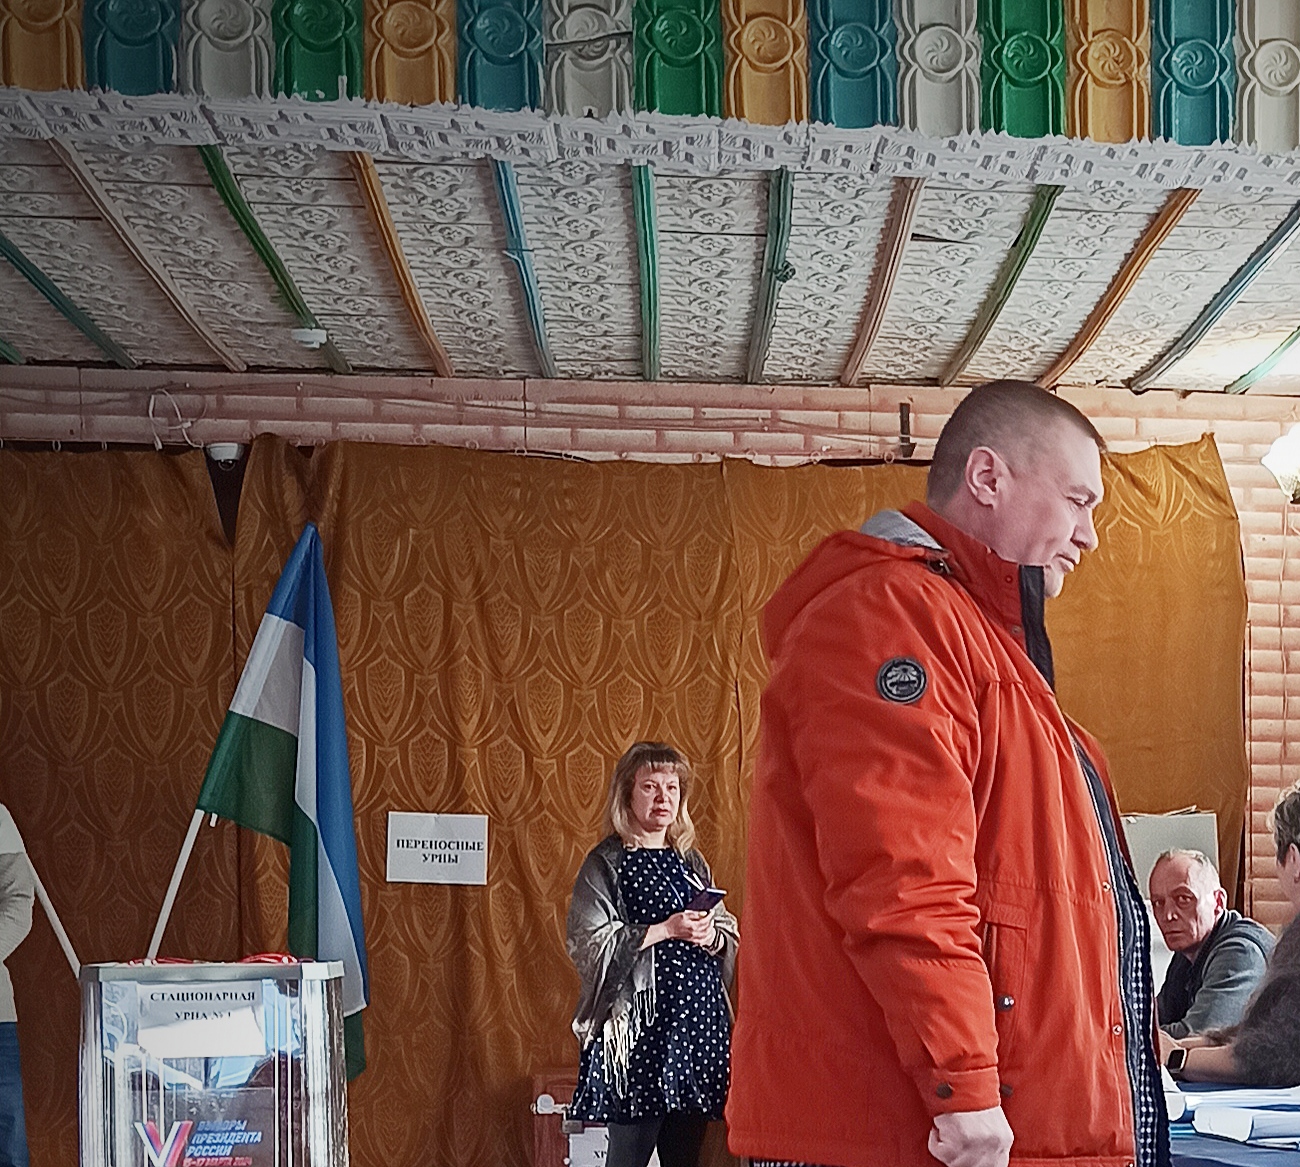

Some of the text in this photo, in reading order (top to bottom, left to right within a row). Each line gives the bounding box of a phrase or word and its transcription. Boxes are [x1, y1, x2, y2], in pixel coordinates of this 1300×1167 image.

[396, 839, 484, 851] ПЕРЕНОСНЫЕ
[422, 853, 459, 864] УРНЫ
[150, 991, 255, 1001] СТАЦИОНАРНАЯ
[174, 1011, 209, 1021] УРНА
[191, 1132, 262, 1145] ПРЕЗИДЕНТА
[185, 1145, 233, 1158] РОССИИ
